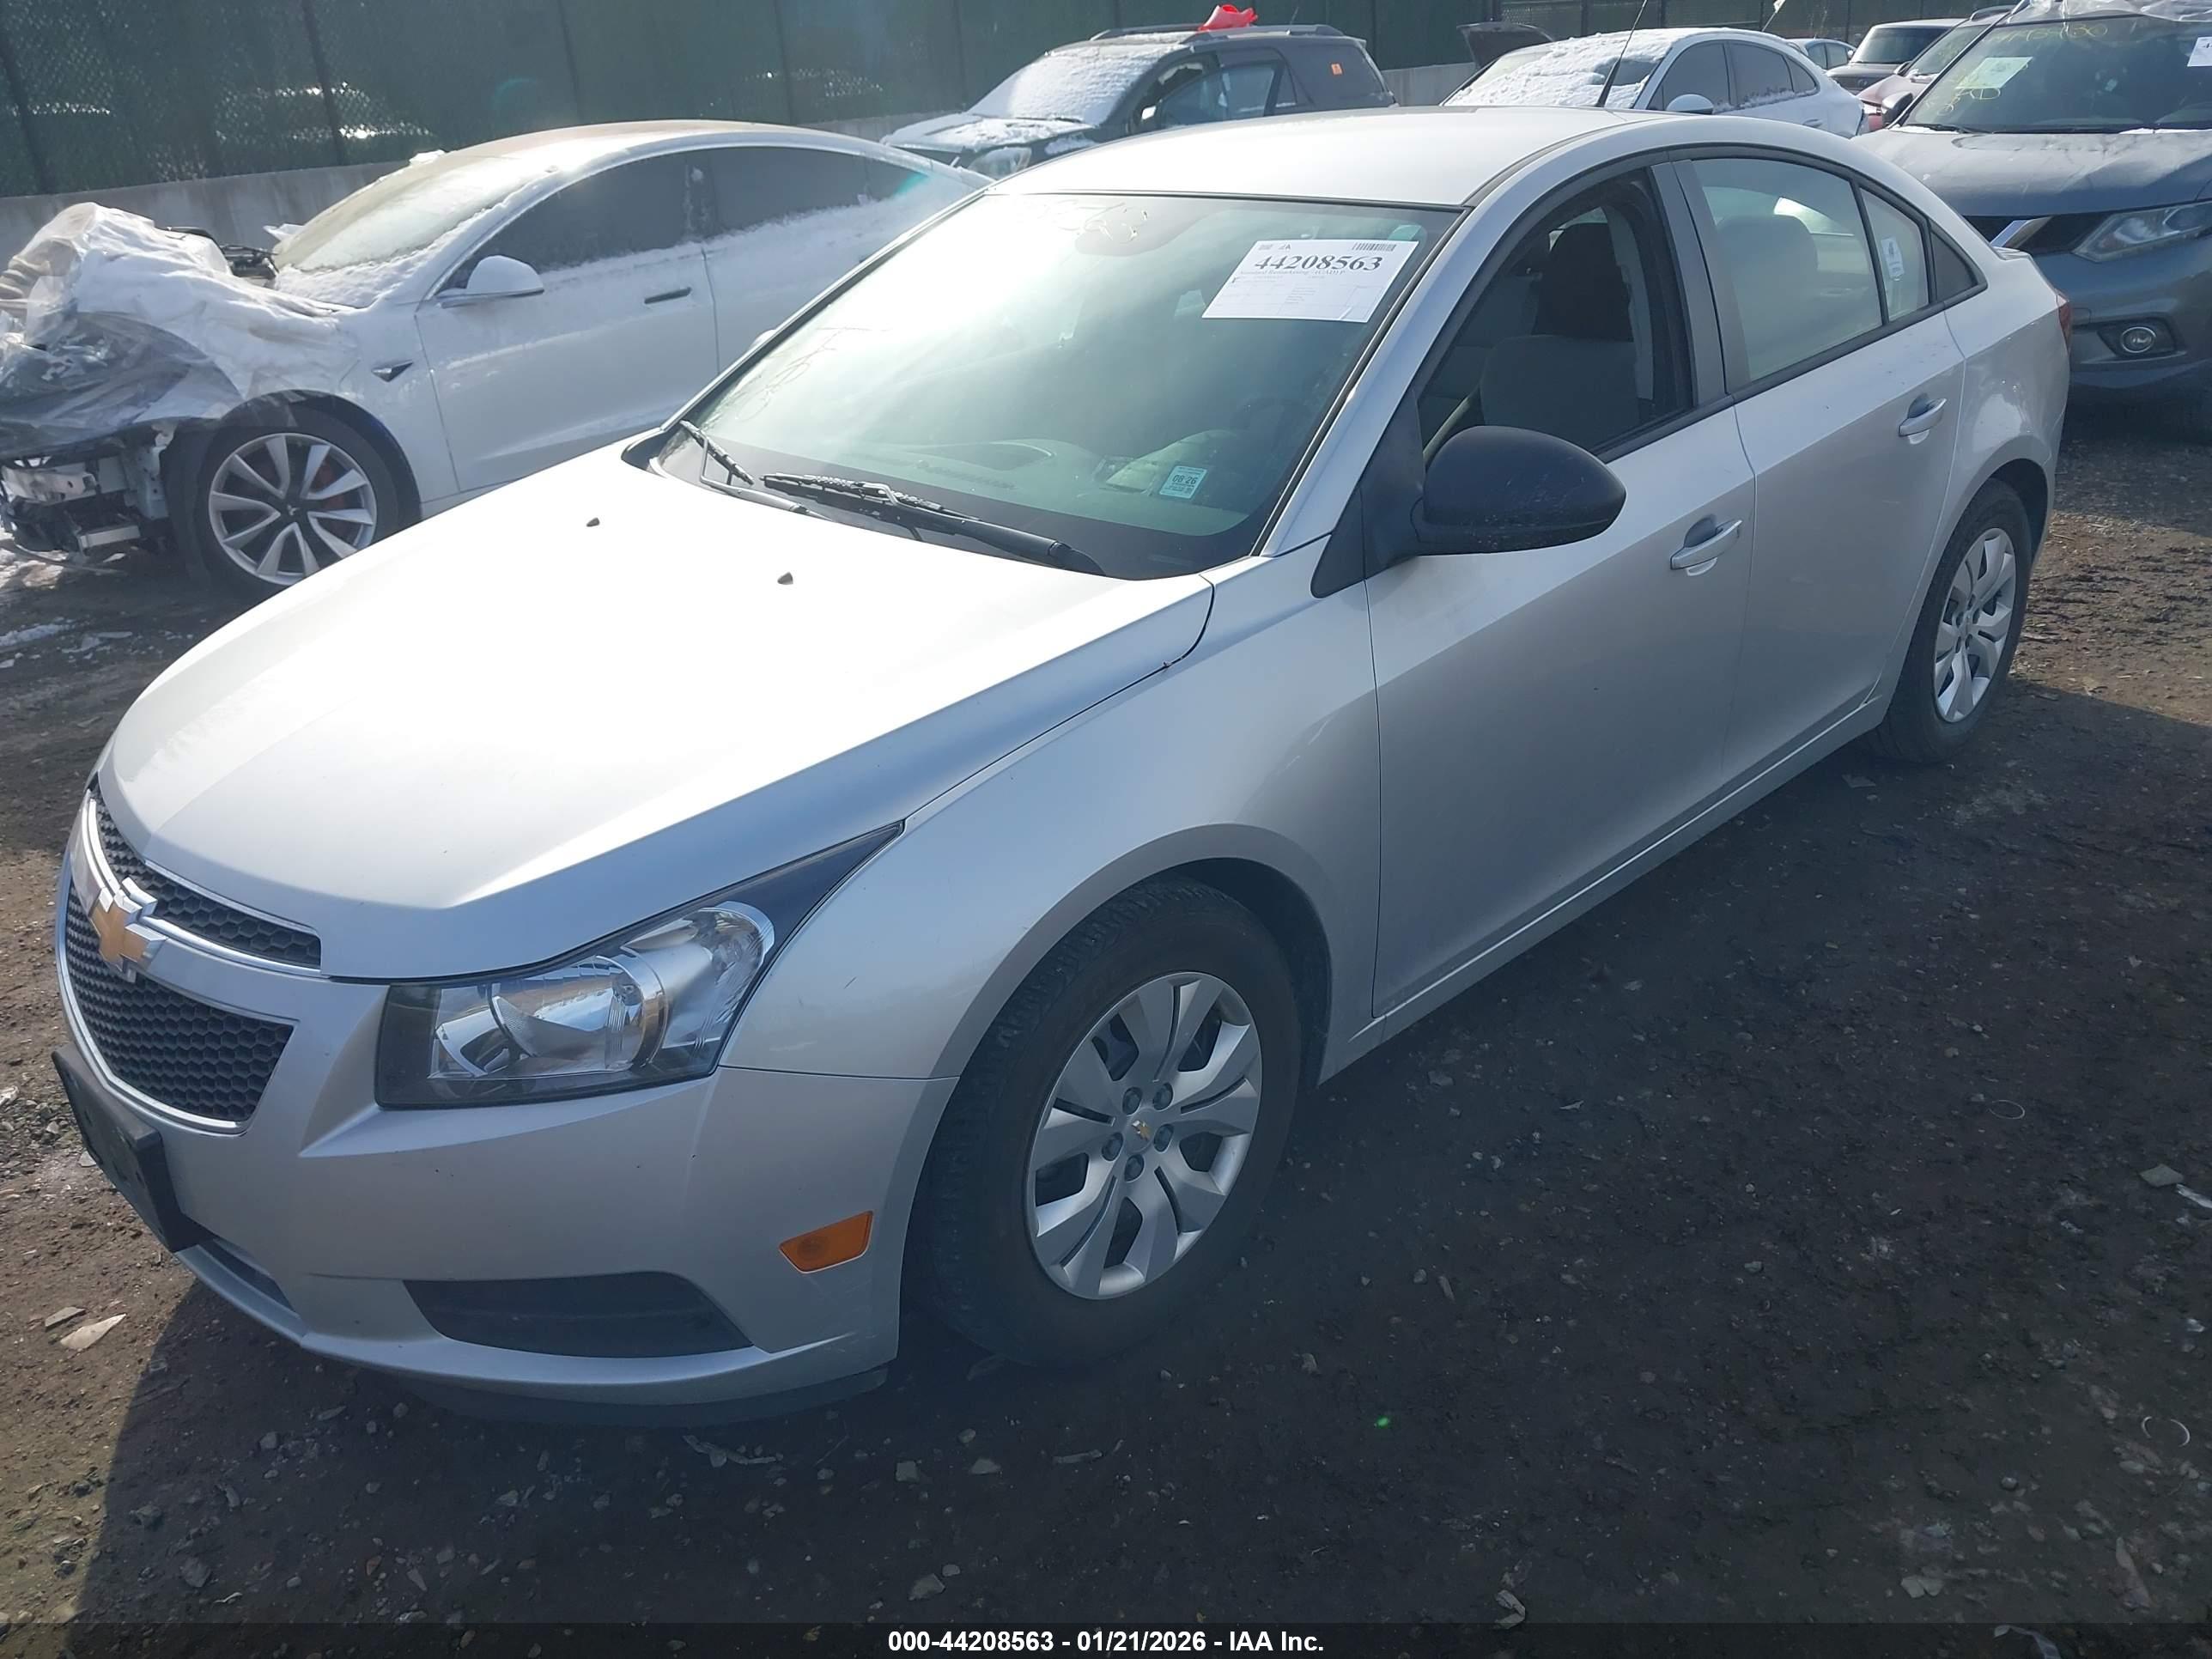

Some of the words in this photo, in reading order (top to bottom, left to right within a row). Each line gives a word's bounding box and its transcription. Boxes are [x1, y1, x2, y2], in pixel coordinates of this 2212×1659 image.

[1255, 255, 1382, 270] 44208563
[1172, 474, 1185, 483] 08
[1185, 476, 1199, 484] 26
